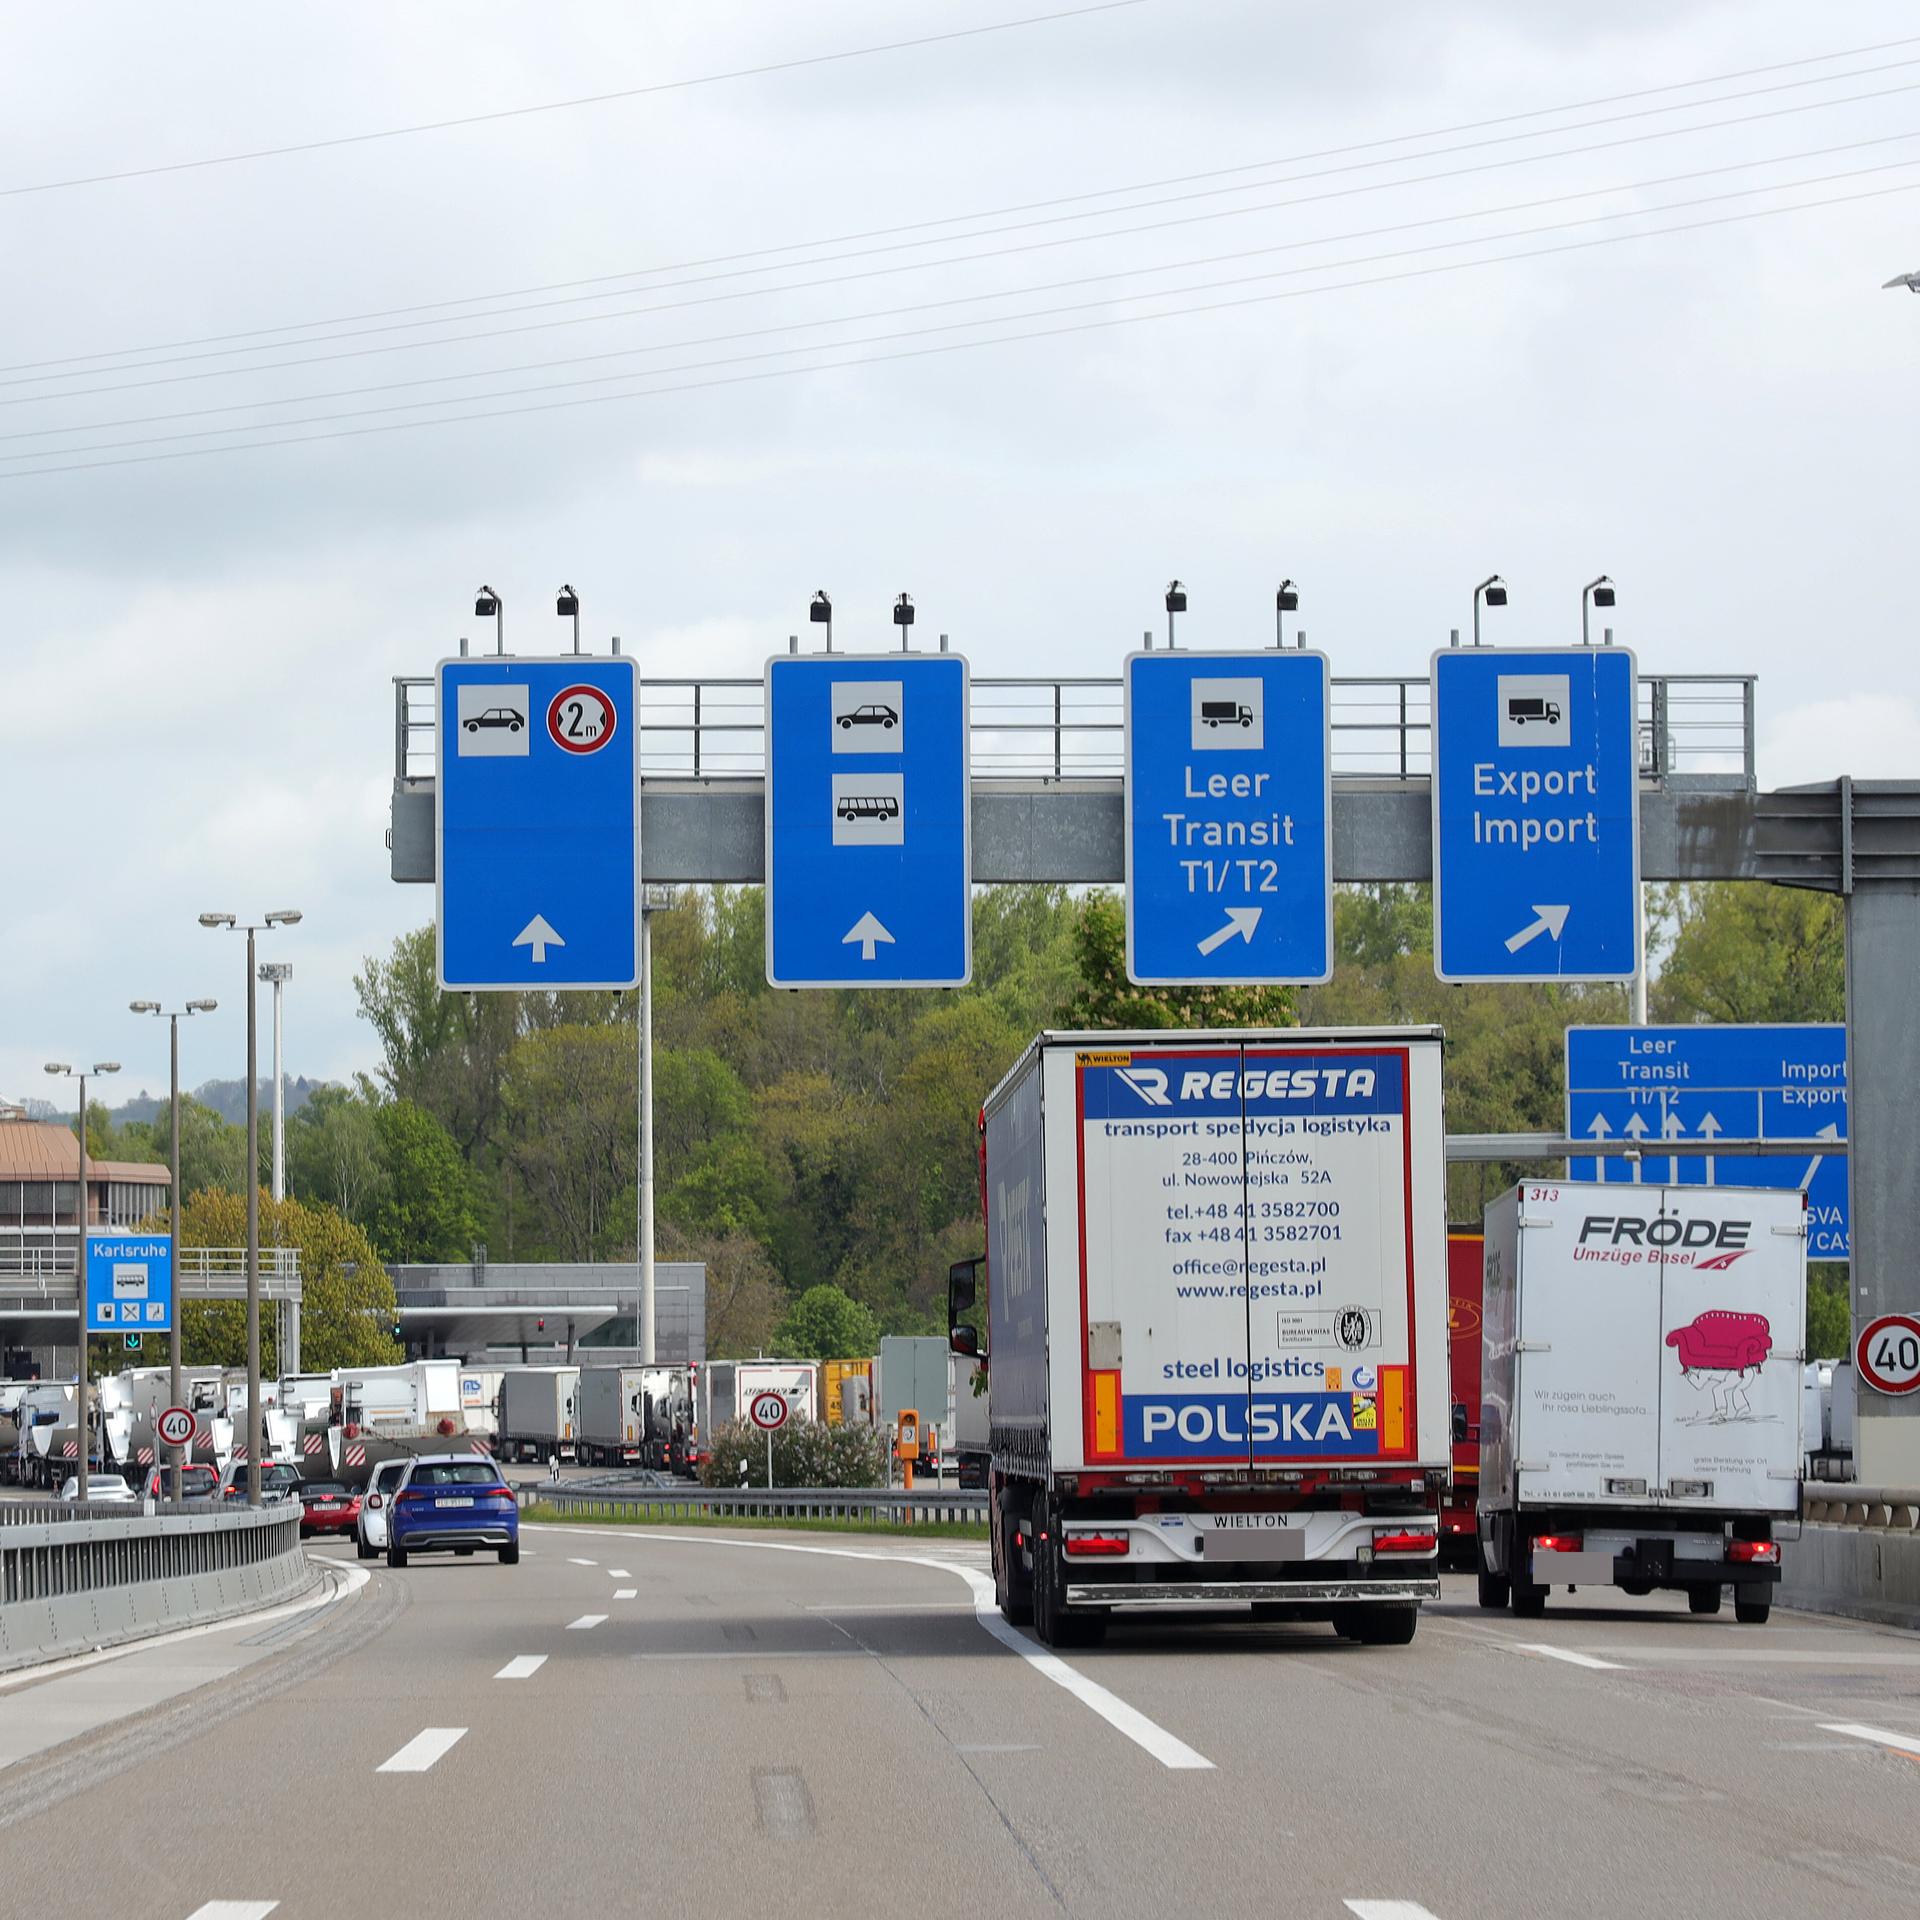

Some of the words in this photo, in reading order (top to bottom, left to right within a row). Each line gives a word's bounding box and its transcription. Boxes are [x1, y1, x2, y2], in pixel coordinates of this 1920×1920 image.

[567, 702, 584, 738] 2
[585, 724, 597, 738] m
[1185, 766, 1270, 798] Leer
[1474, 763, 1596, 803] Export
[1163, 813, 1294, 847] Transit
[1474, 811, 1596, 852] Import
[1630, 1037, 1676, 1055] Leer
[1093, 1055, 1129, 1063] WIELTON
[1618, 1061, 1690, 1080] Transit
[1782, 1060, 1847, 1082] Import
[1180, 1068, 1376, 1100] REGESTA
[1626, 1086, 1680, 1105] T1/T2
[1105, 1119, 1199, 1138] transport
[1206, 1118, 1296, 1138] spedycja
[1302, 1116, 1391, 1136] logistyka
[1182, 1151, 1238, 1166] 28-400
[1246, 1149, 1313, 1165] Pińczów,
[1162, 1171, 1180, 1187] ul.
[1185, 1171, 1289, 1187] Nowowiejska
[1301, 1170, 1332, 1184] 52A
[1531, 1188, 1559, 1202] 313
[1167, 1202, 1228, 1219] tel.+48
[1234, 1202, 1256, 1218] 41
[1261, 1202, 1340, 1217] 3582700
[1165, 1227, 1191, 1245] fax
[1197, 1228, 1231, 1242] +48
[1234, 1228, 1257, 1242] 41
[1264, 1225, 1342, 1241] 3582701
[1578, 1209, 1751, 1248] FRÖDE
[93, 1243, 167, 1258] Karlsruhe
[1574, 1247, 1642, 1266] Umzüge
[1647, 1249, 1695, 1265] Basel
[1172, 1257, 1327, 1276] office@regesta.pl
[1176, 1281, 1323, 1300] www.regesta.pl
[1875, 1336, 1920, 1371] 40
[1163, 1358, 1220, 1379] steel
[1227, 1356, 1325, 1382] logistics
[1534, 1389, 1549, 1400] Wir
[1588, 1391, 1616, 1402] auch
[758, 1402, 780, 1420] 40
[1542, 1403, 1554, 1413] Ihr
[1557, 1405, 1579, 1414] rosa
[165, 1417, 188, 1435] 40
[1143, 1402, 1352, 1443] POLSKA
[1214, 1514, 1288, 1528] WIELTON
